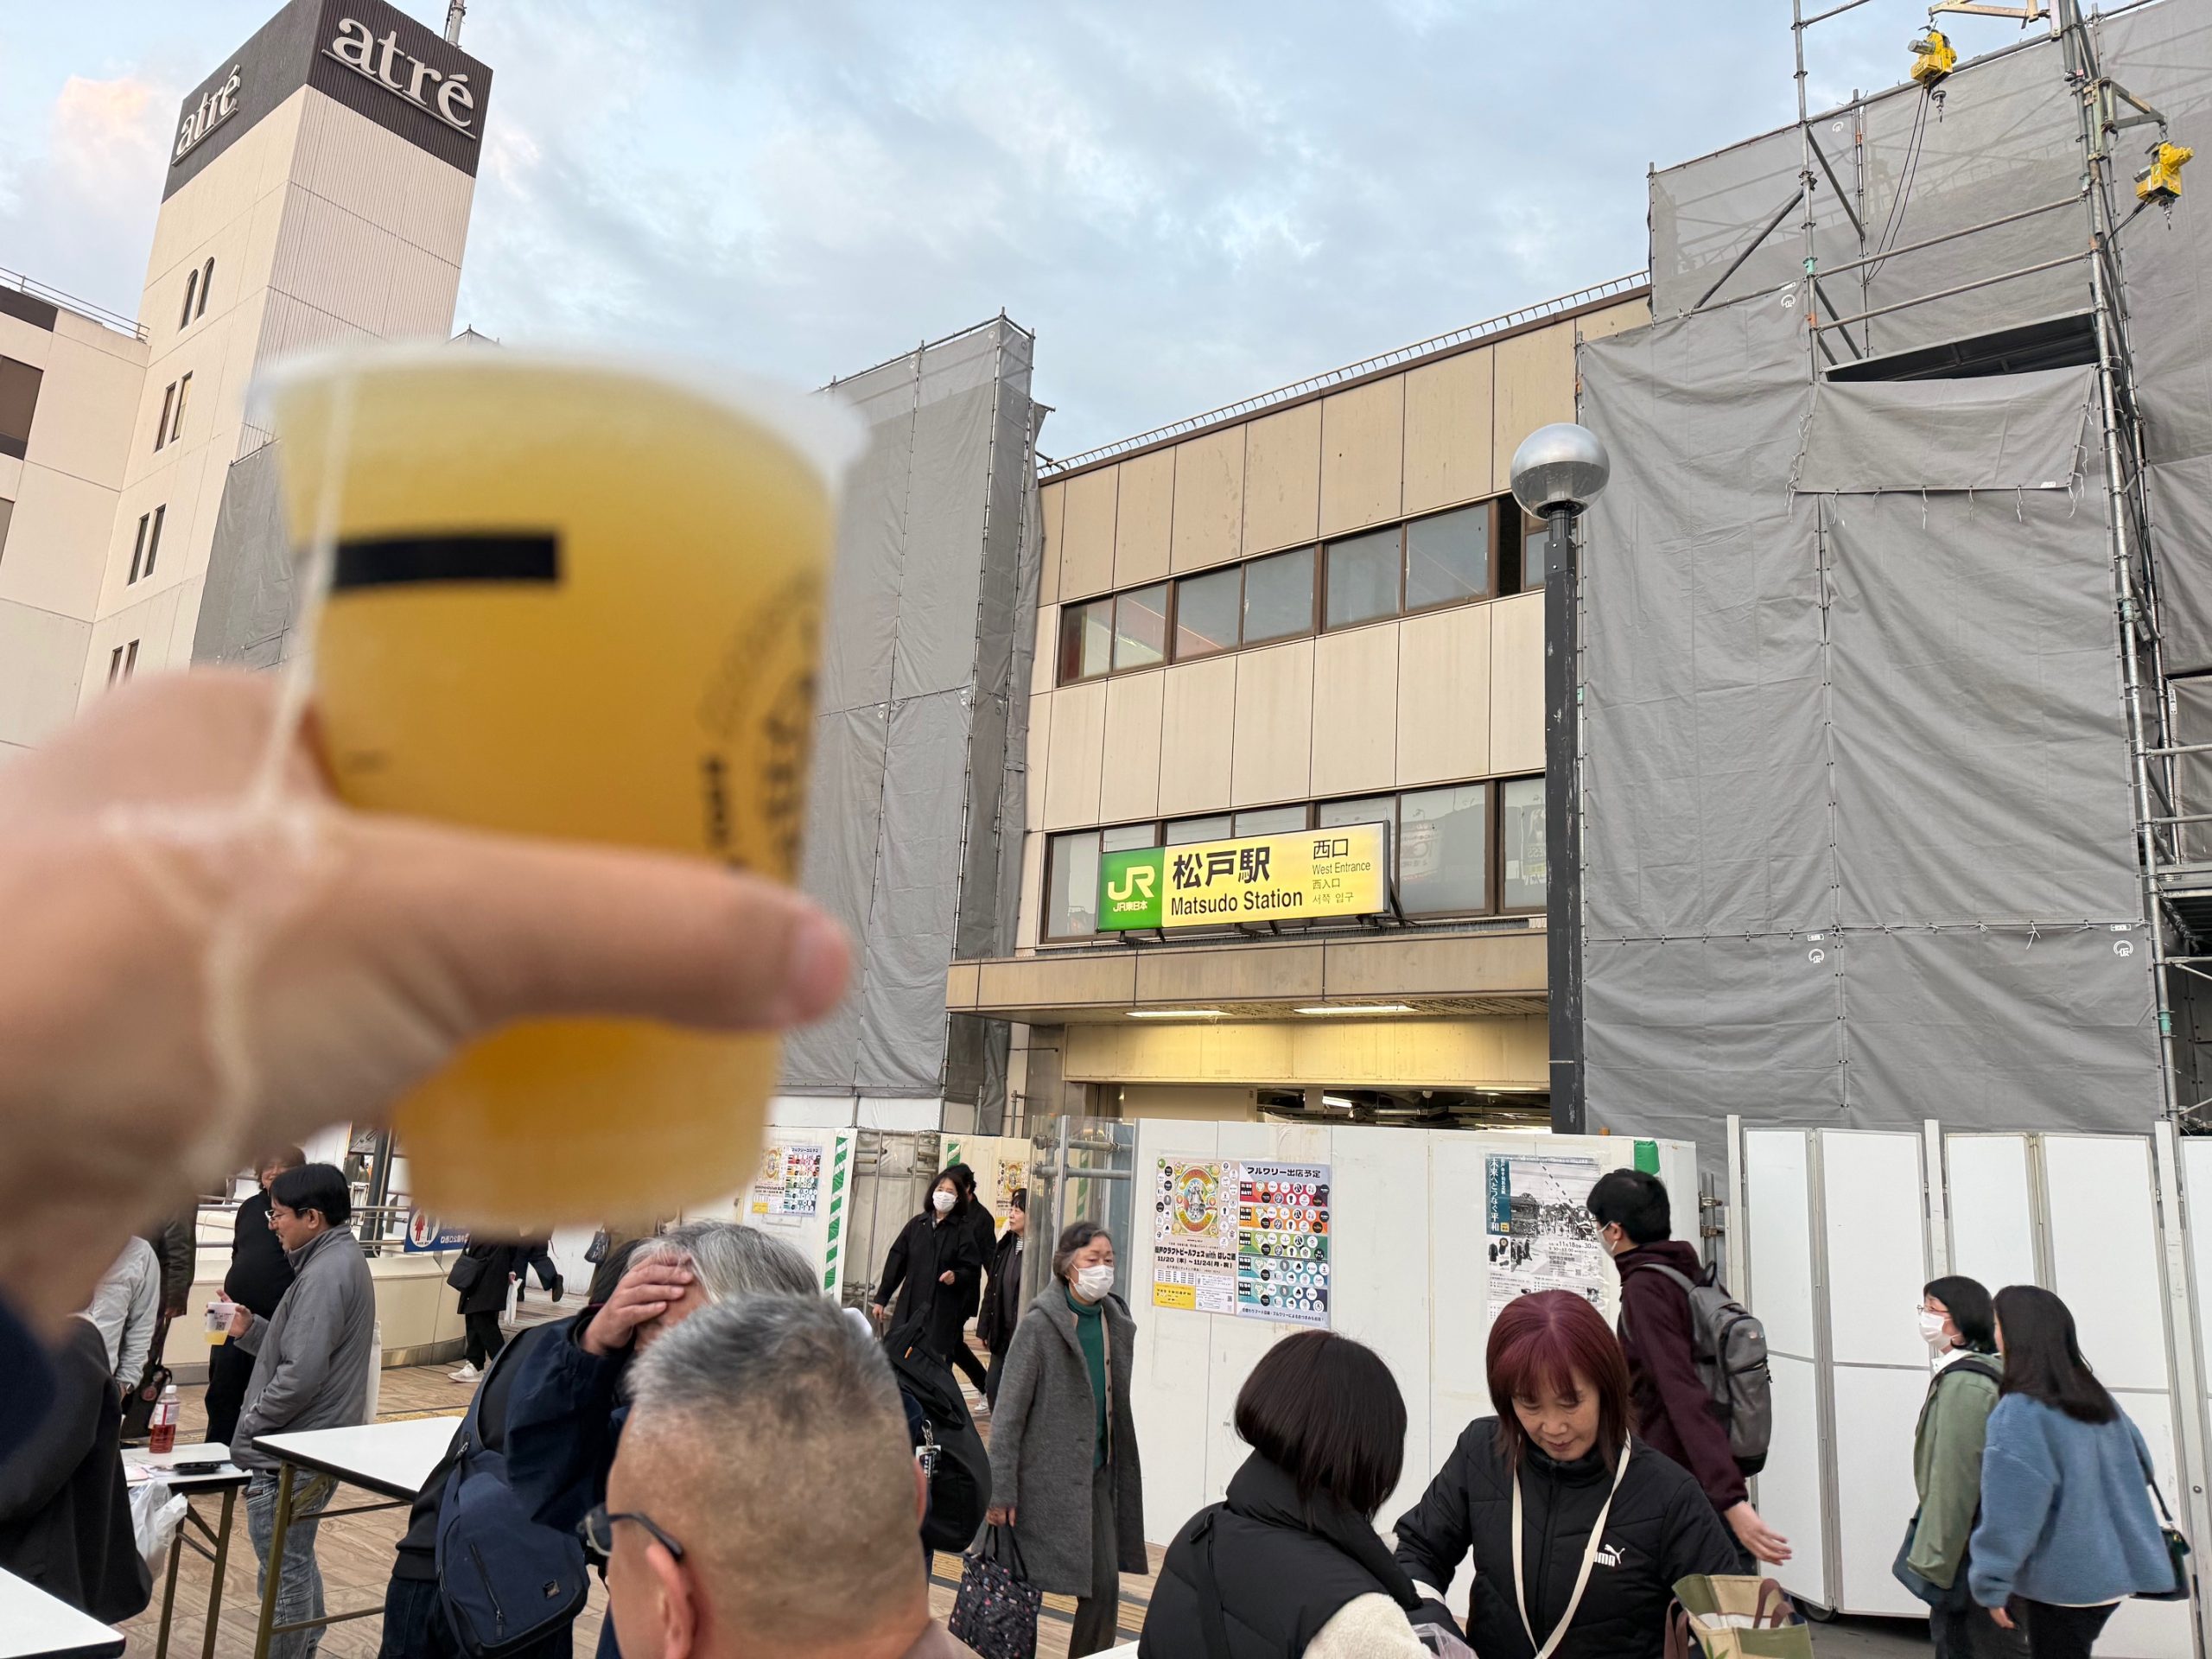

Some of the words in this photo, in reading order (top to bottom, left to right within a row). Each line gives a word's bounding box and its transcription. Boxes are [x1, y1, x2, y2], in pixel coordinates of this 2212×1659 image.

[332, 17, 474, 128] atré
[176, 65, 241, 156] atré
[1313, 838, 1349, 860] 西口
[1172, 846, 1271, 890] 松戸駅
[1313, 862, 1333, 875] West
[1334, 861, 1371, 874] Entrance
[1107, 865, 1155, 901] JR
[1313, 878, 1341, 890] 西入口
[1112, 900, 1148, 913] JR東日本
[1171, 893, 1238, 916] Matsudo
[1243, 888, 1303, 911] Station
[1313, 893, 1332, 905] 서쪽
[1335, 892, 1355, 904] 입구
[1593, 1552, 1616, 1567] MA
